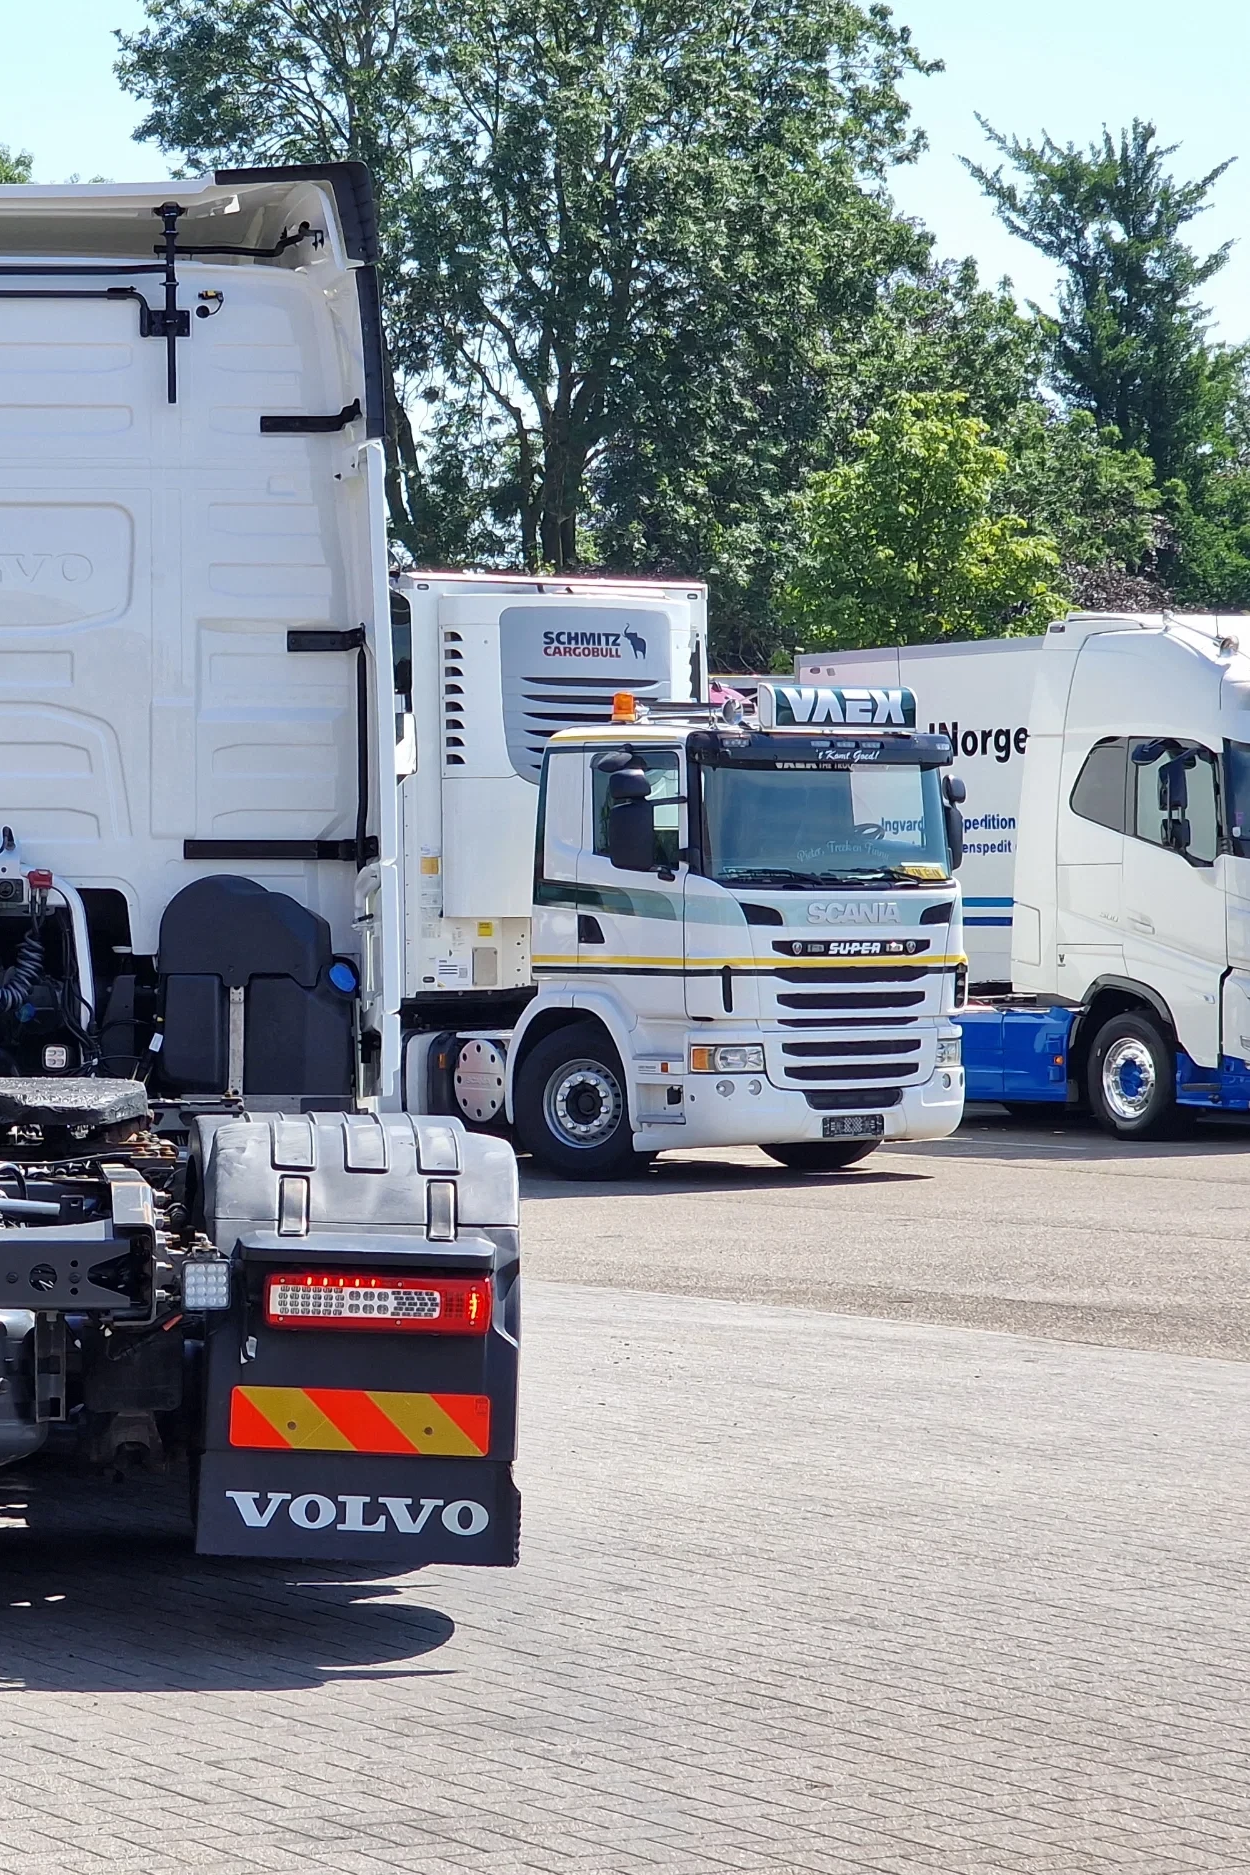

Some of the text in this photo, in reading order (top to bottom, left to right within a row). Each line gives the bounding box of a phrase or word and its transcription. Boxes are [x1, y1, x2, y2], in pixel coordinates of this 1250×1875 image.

[543, 631, 621, 646] SCHMITZ
[543, 646, 621, 658] CARGOBULL
[780, 687, 905, 724] VAEX
[963, 814, 1016, 834] pedition
[807, 902, 901, 925] SCANIA
[828, 942, 881, 955] SUPER
[225, 1490, 490, 1536] VOLVO
